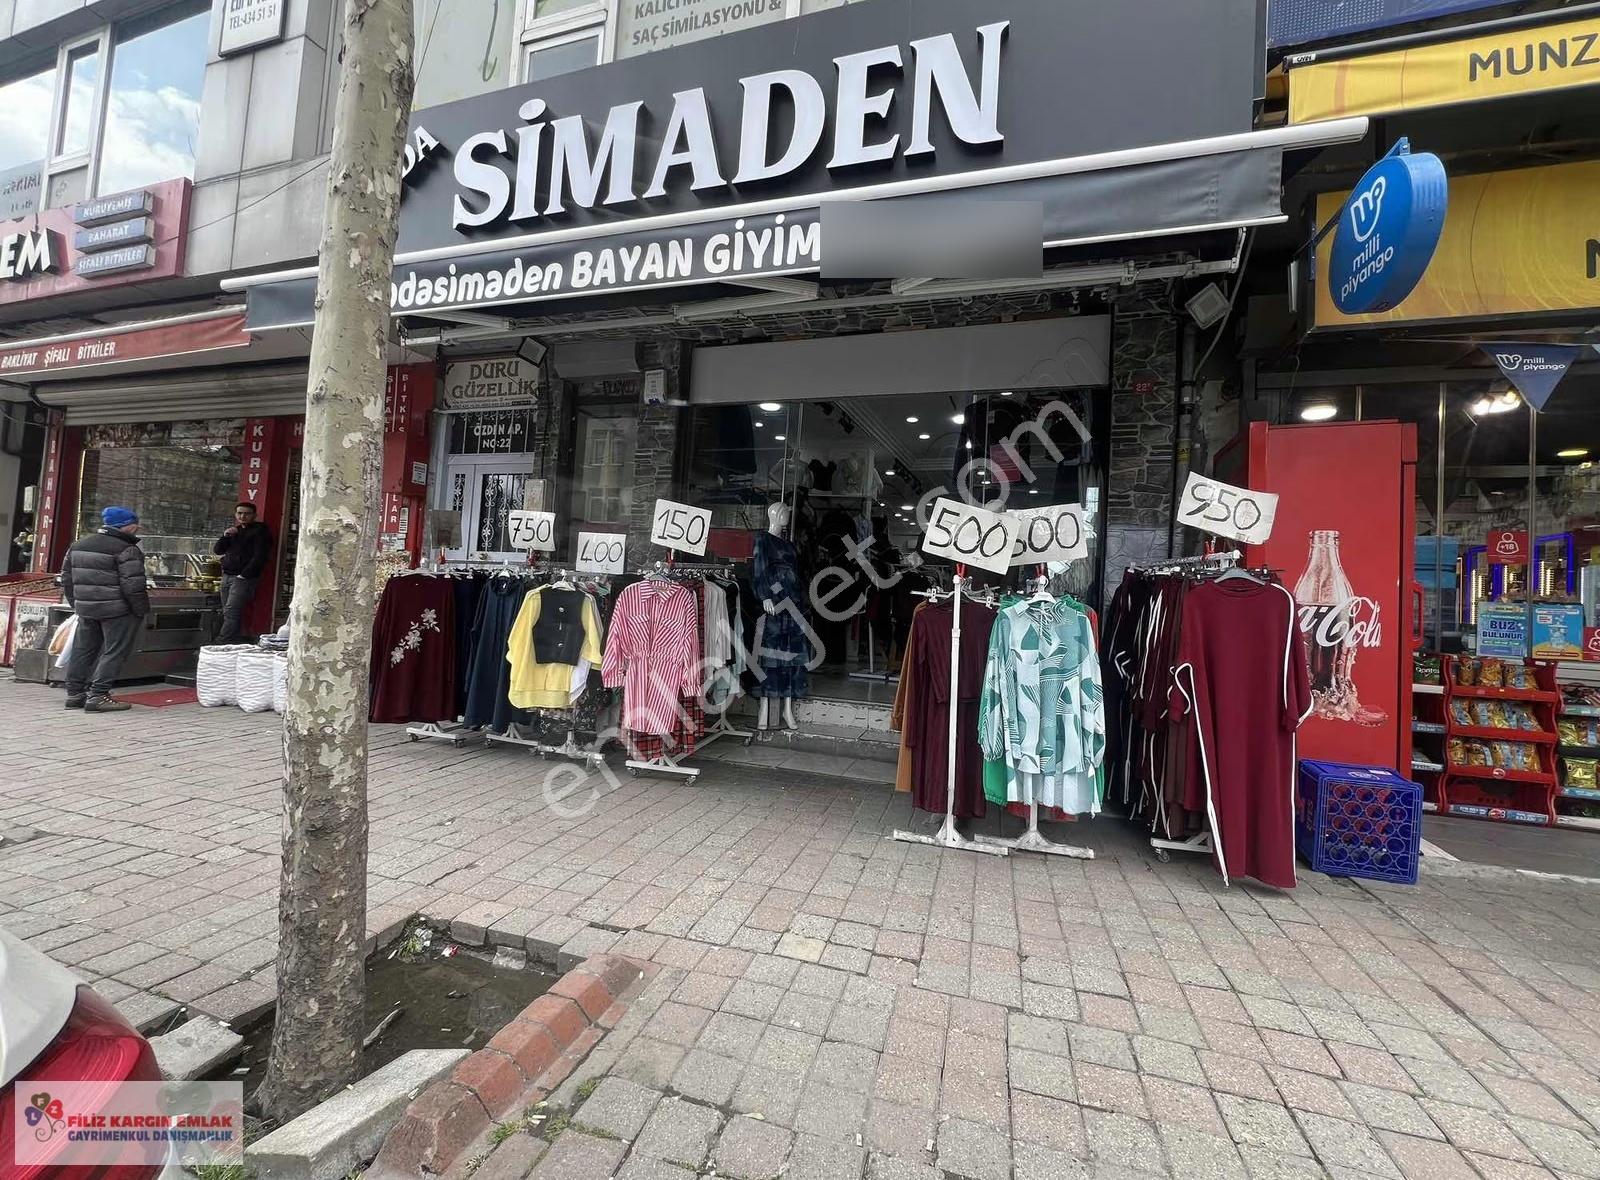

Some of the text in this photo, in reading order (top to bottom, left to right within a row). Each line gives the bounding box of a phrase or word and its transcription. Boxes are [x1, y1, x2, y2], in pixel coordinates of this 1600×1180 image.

[632, 26, 659, 46] SAÇ
[661, 3, 765, 40] SİMİLASYONU
[1469, 32, 1600, 82] MUNZ
[453, 20, 1011, 231] SİMADEN
[570, 238, 693, 289] BAYAN
[703, 213, 821, 274] GİYİM
[1352, 233, 1381, 272] milli
[1340, 246, 1394, 303] piyango
[44, 347, 71, 367] ŞİFALI
[77, 341, 116, 360] BİTKİLER
[470, 360, 520, 380] DURU
[452, 378, 536, 399] GÜZELLİK
[1186, 482, 1261, 530] 950
[511, 517, 551, 543] 750
[657, 508, 706, 545] 150
[928, 507, 1009, 557] 500
[580, 539, 623, 563] 400
[1482, 631, 1523, 640] BULUNUR
[1489, 620, 1517, 631] BUZ
